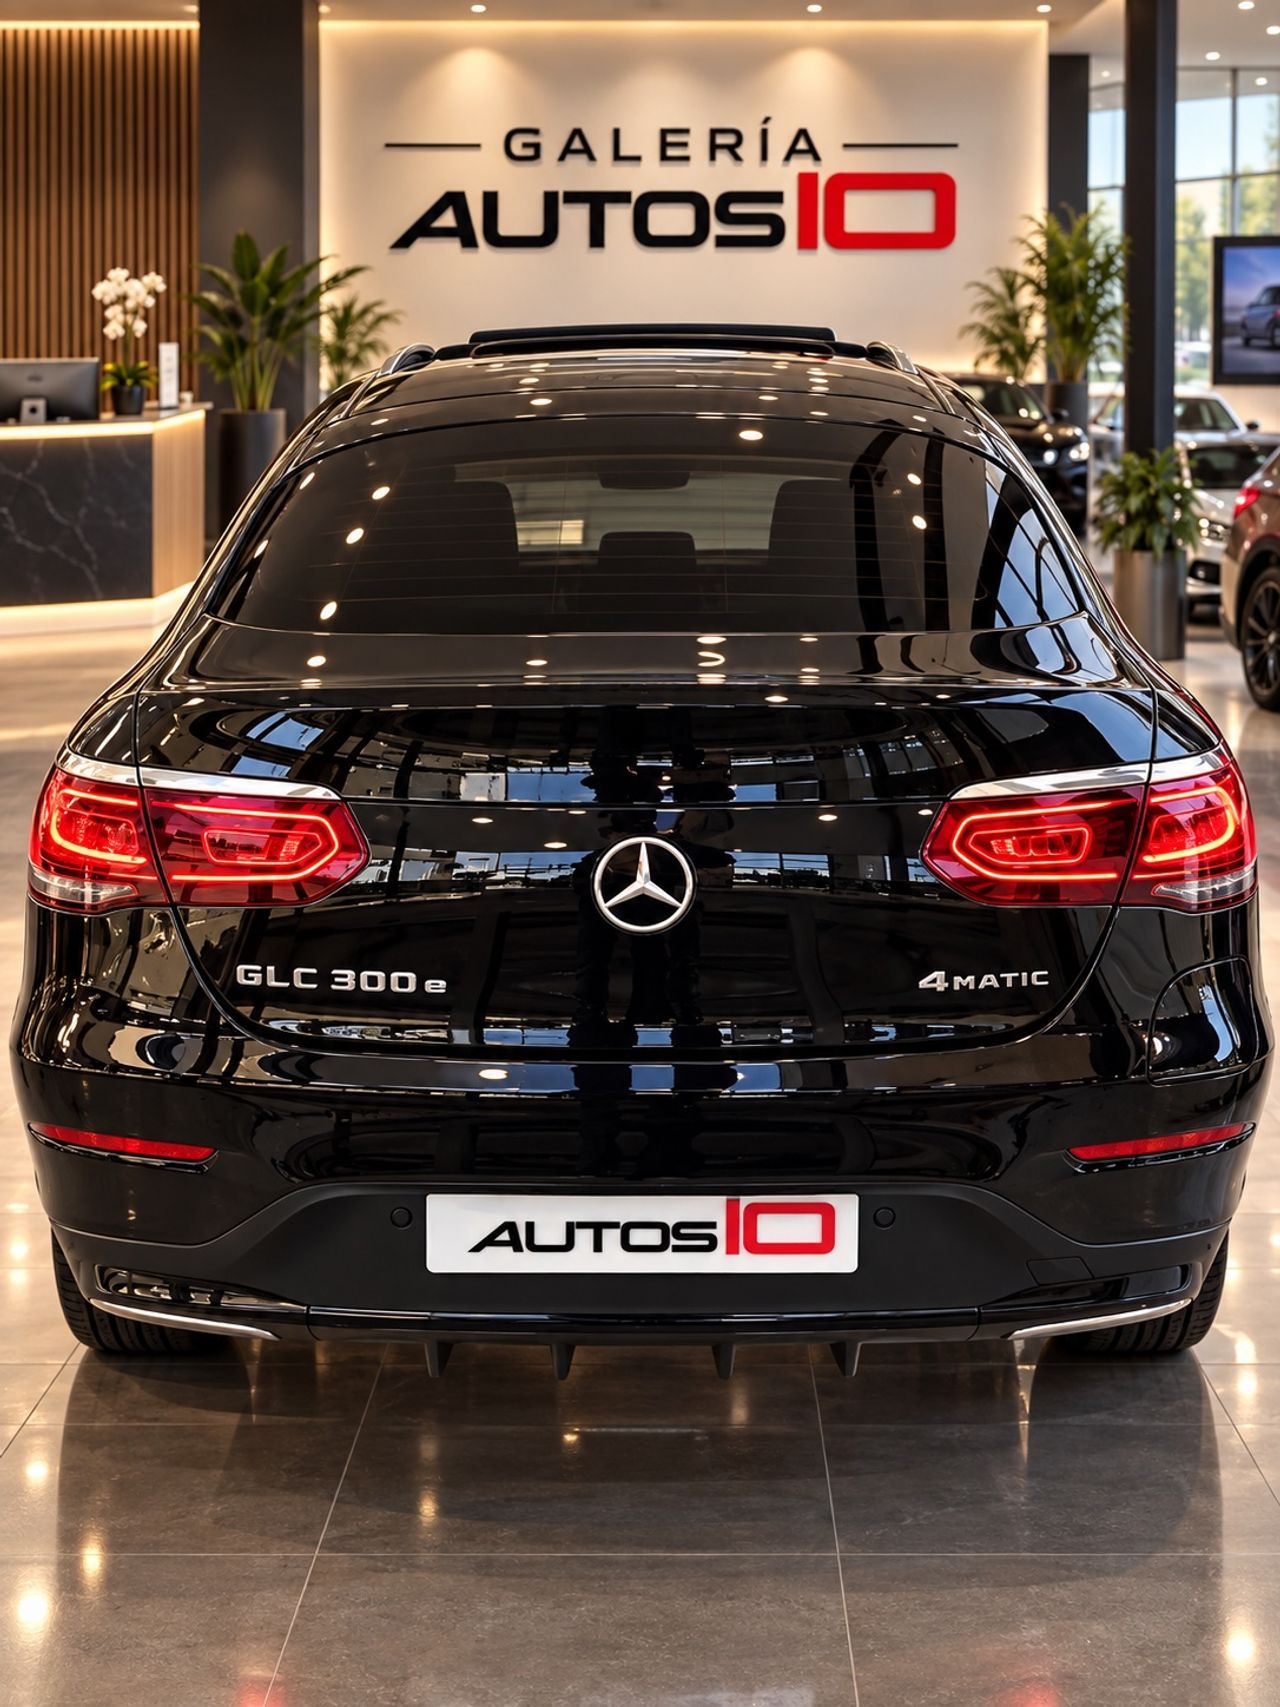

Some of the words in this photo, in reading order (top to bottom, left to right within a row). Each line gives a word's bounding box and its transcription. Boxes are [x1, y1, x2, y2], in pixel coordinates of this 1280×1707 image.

[503, 116, 822, 163] GALERÍA
[236, 964, 318, 990] GLC
[918, 970, 1050, 992] 4MATIC
